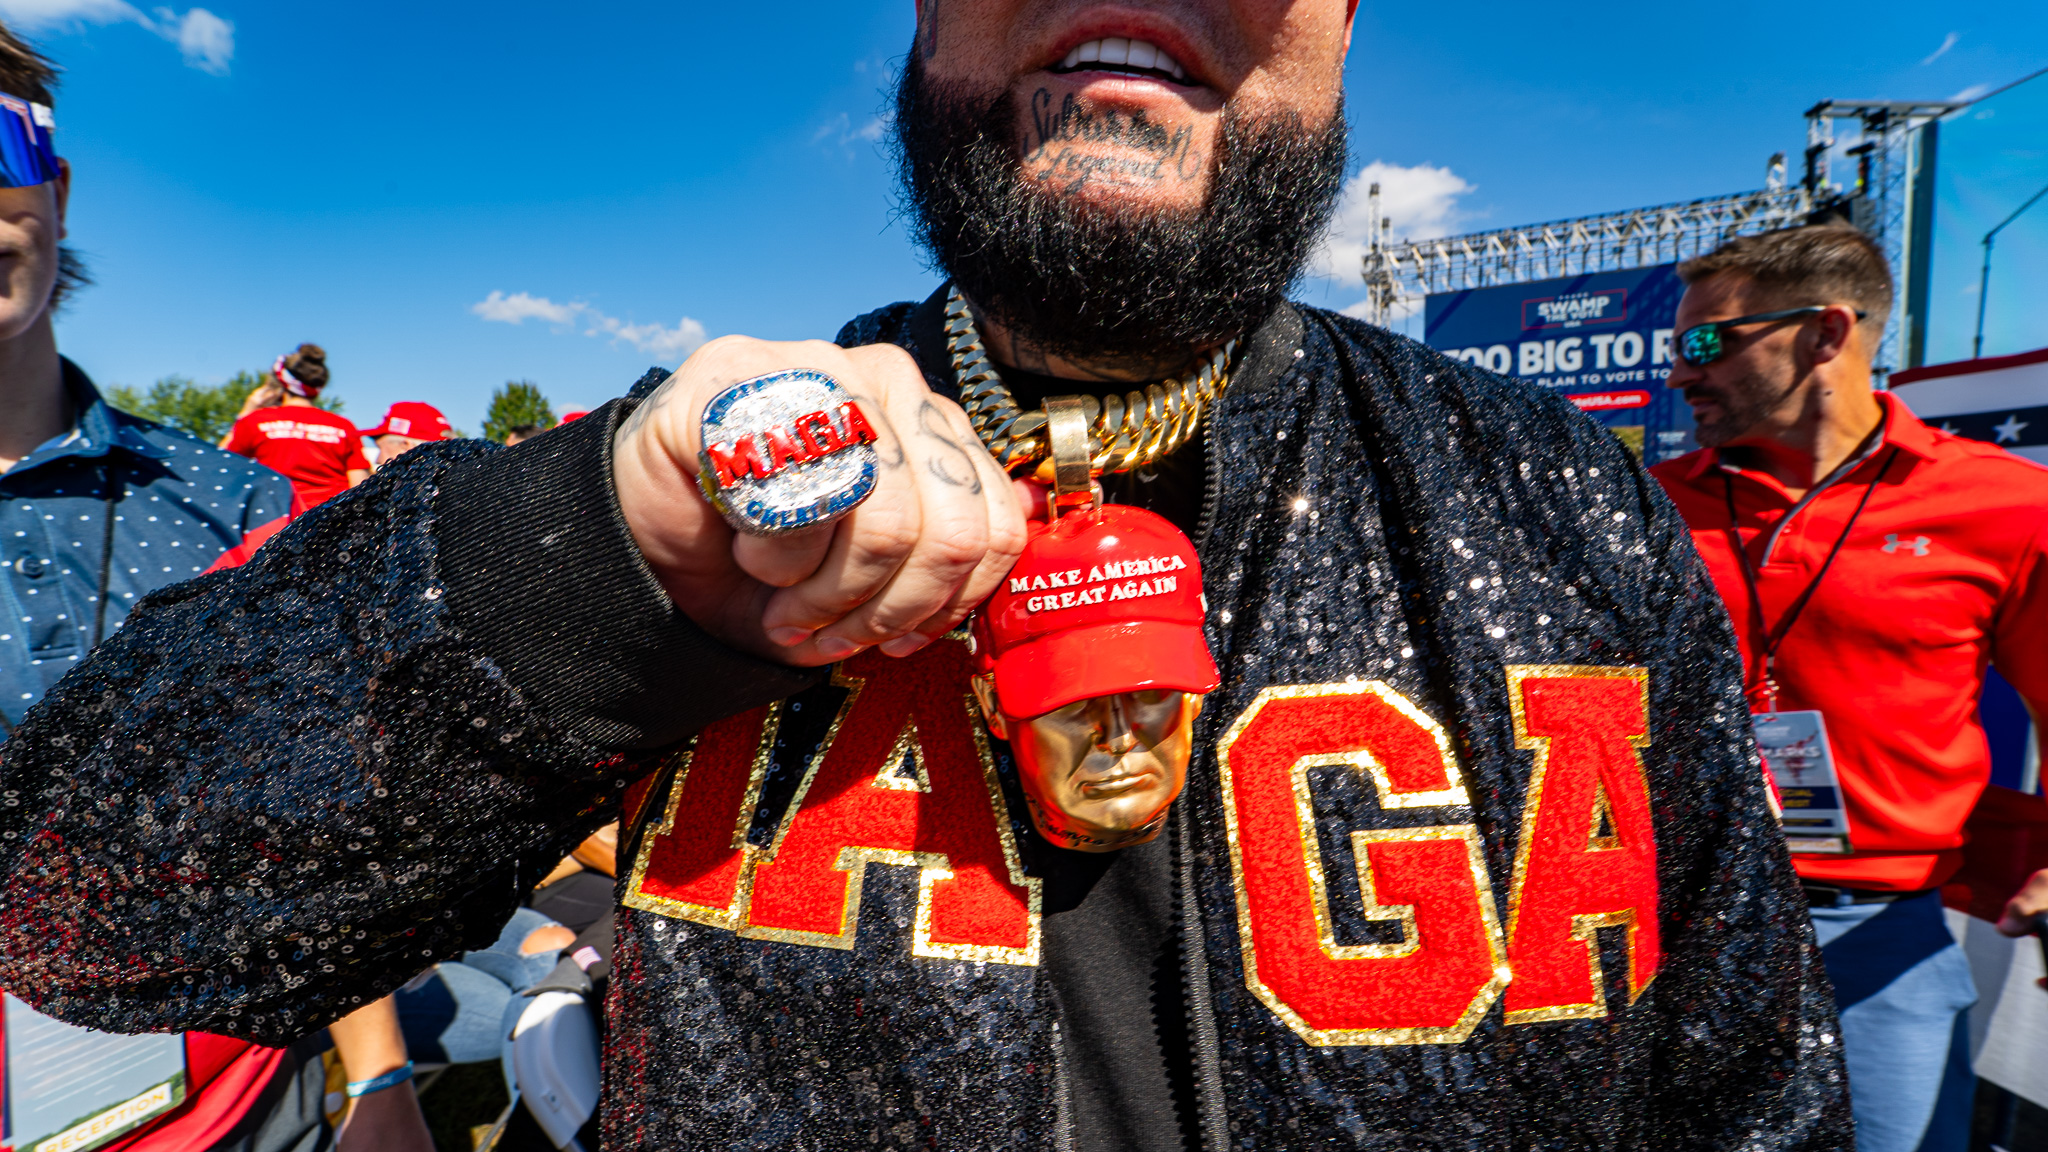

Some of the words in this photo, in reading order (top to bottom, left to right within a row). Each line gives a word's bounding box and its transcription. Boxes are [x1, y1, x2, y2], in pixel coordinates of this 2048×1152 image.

[1538, 296, 1610, 316] SWAMP
[1546, 313, 1567, 322] THE
[1571, 309, 1602, 320] VOTE
[1441, 345, 1512, 375] OO
[1518, 337, 1583, 376] BIG
[1590, 331, 1645, 369] TO
[1652, 329, 1675, 365] R
[1537, 376, 1576, 387] PLAN
[1581, 373, 1600, 385] TO
[1605, 370, 1646, 383] VOTE
[1651, 368, 1672, 379] TO
[258, 420, 295, 432] MAKE
[706, 400, 879, 489] MAGA
[1009, 569, 1084, 593] MAKE
[1087, 555, 1187, 583] AMERICA
[1027, 585, 1107, 612] GREAT
[1109, 575, 1178, 602] AGAIN
[45, 1090, 165, 1152] RECEPTION
